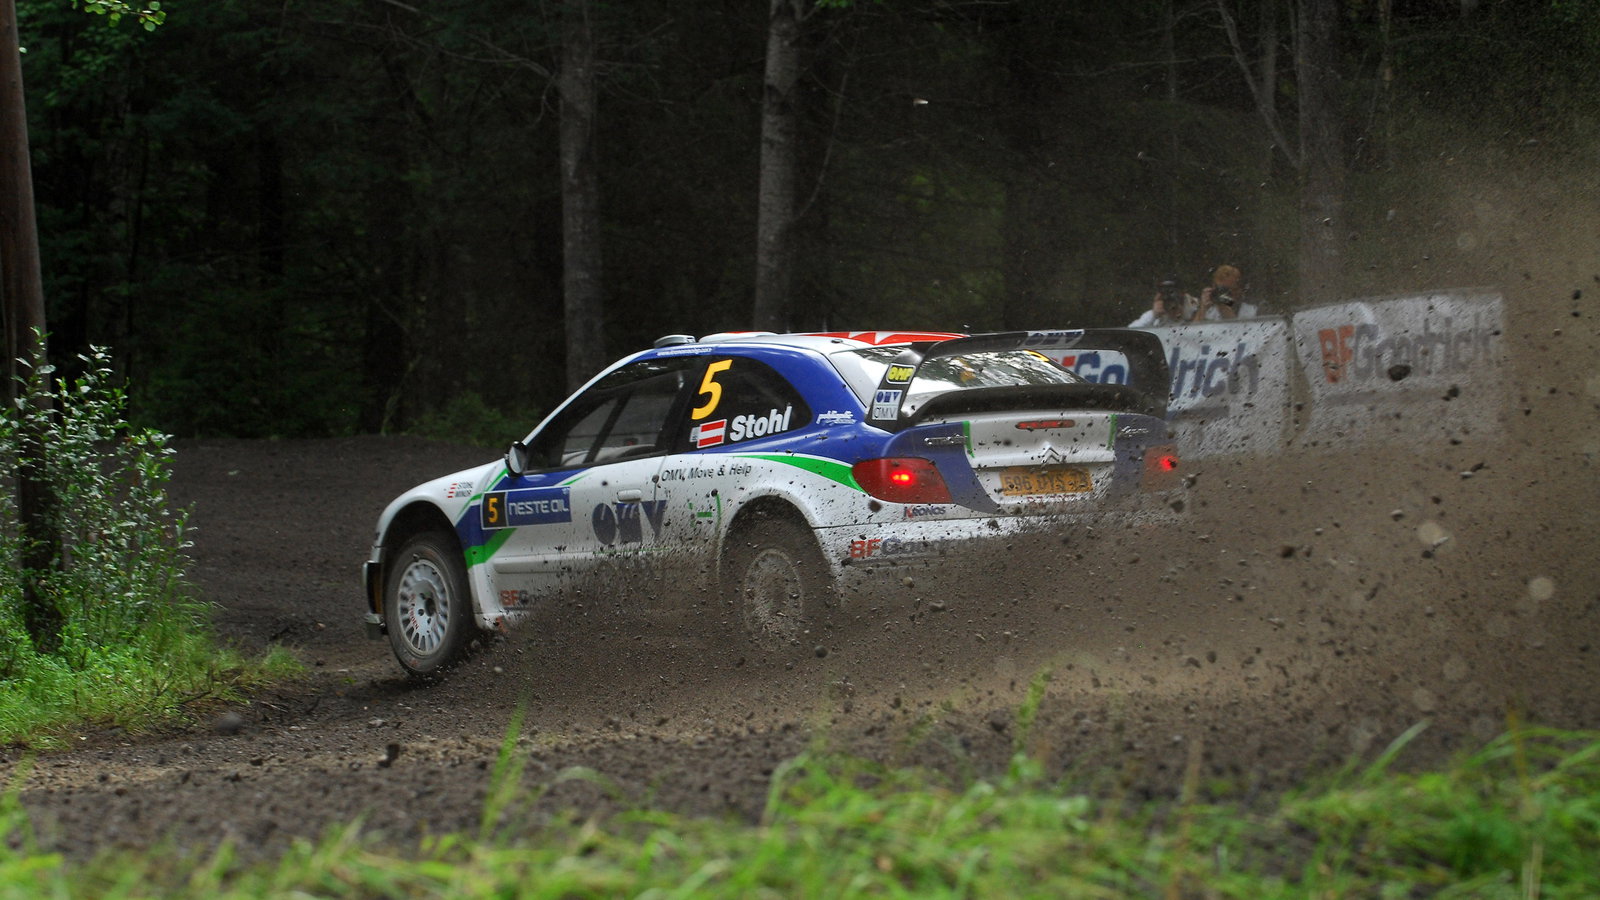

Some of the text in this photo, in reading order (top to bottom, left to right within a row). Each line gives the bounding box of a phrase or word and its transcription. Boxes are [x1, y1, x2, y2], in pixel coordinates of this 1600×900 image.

[691, 359, 733, 420] 5
[876, 391, 900, 403] OMV
[873, 407, 896, 418] OMV
[729, 405, 792, 441] Stohl
[688, 467, 714, 479] Move
[717, 464, 725, 477] &
[729, 462, 752, 477] Help
[487, 497, 499, 523] 5
[508, 498, 570, 516] NESTE OIL
[903, 504, 946, 518] KRONOS
